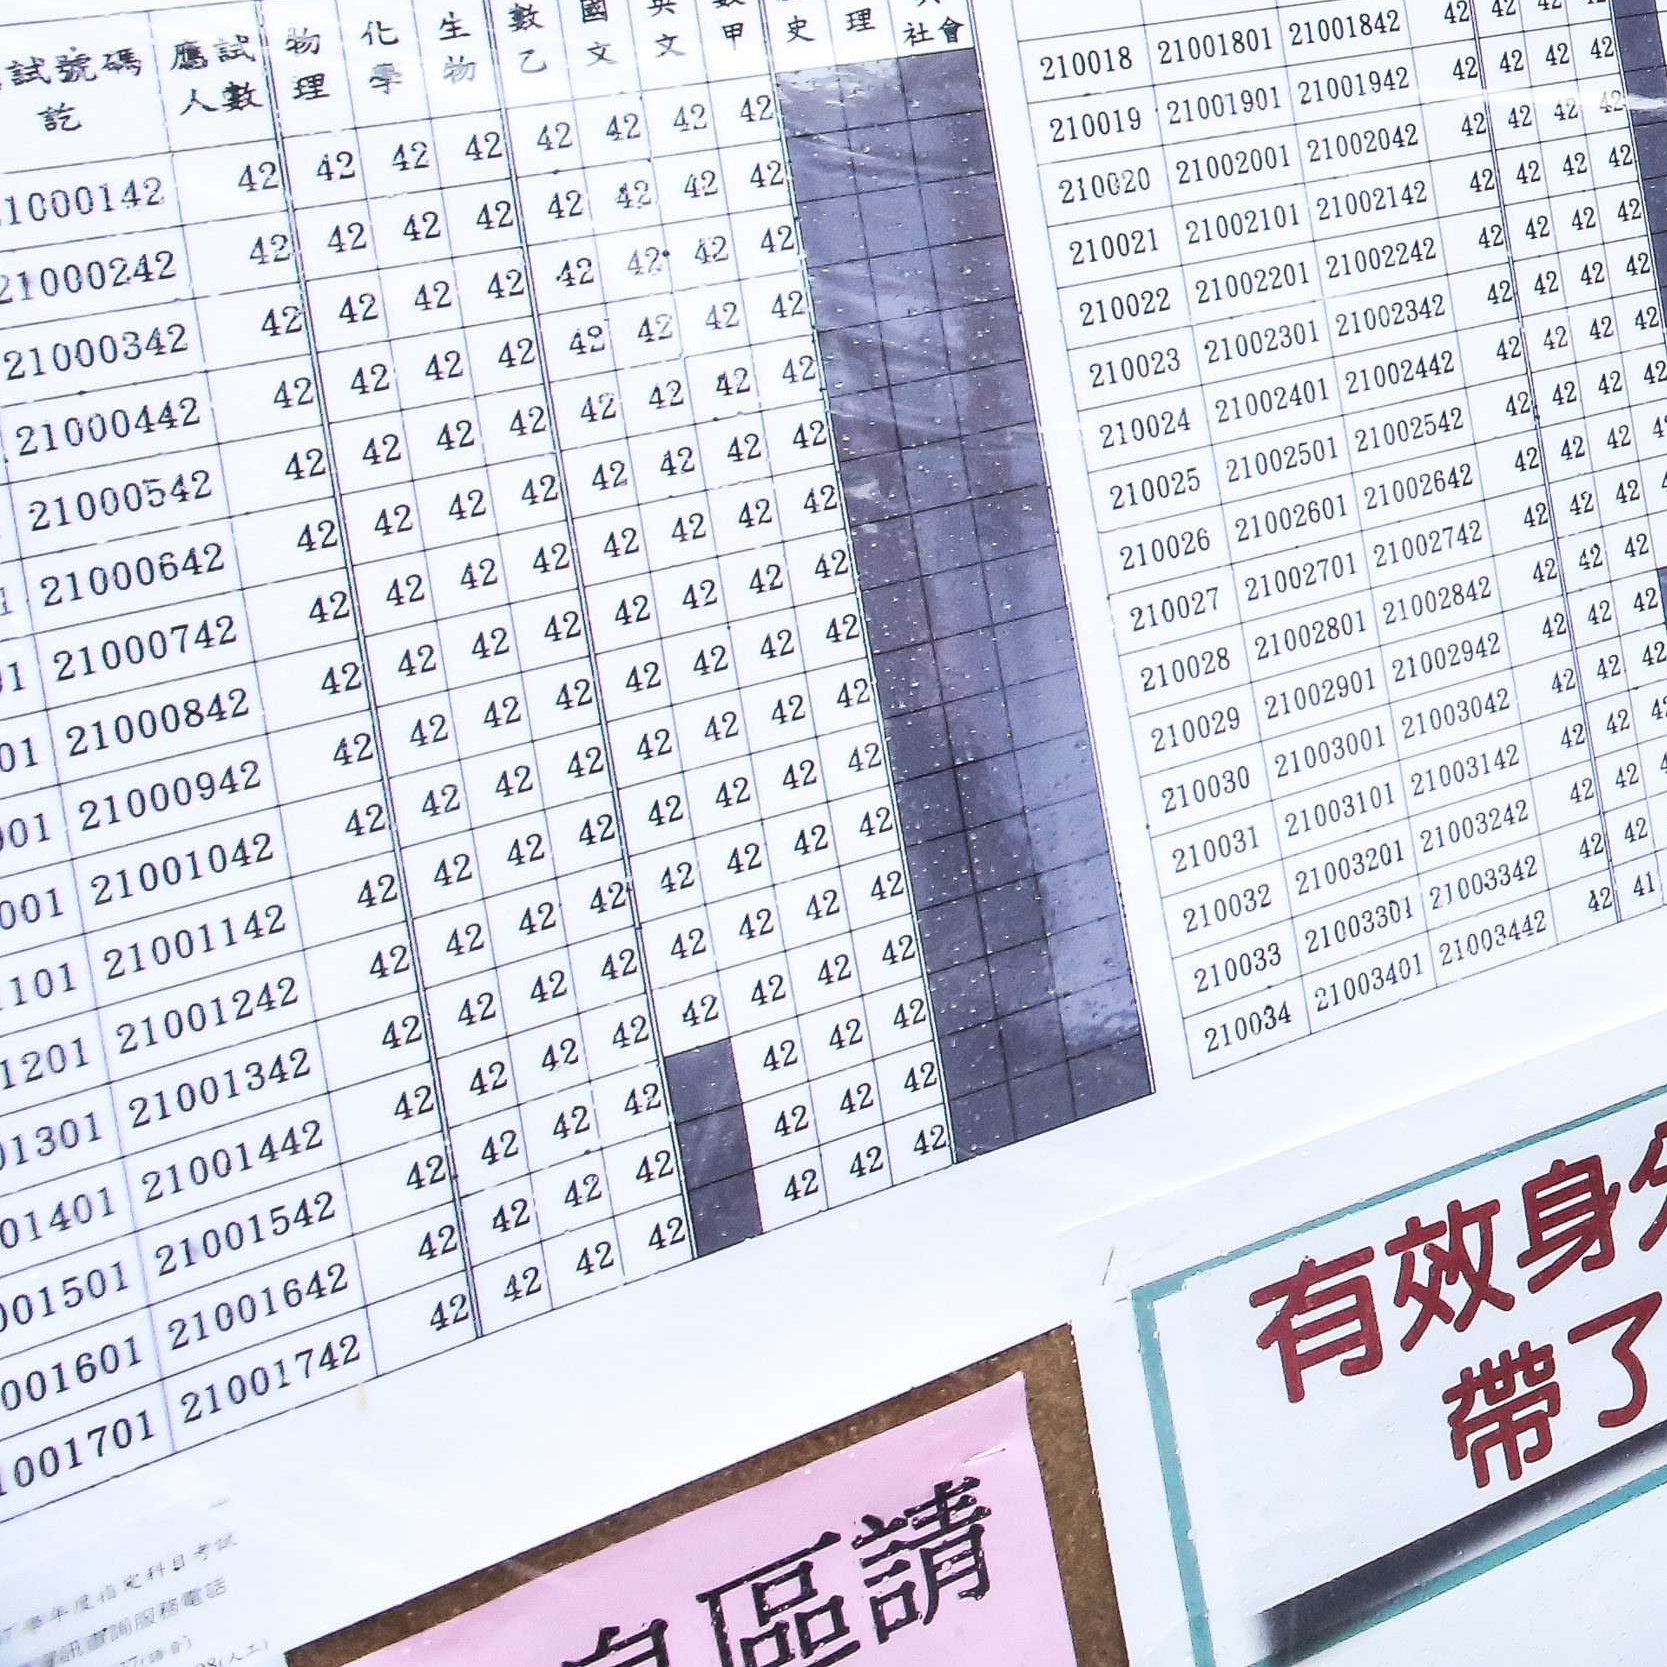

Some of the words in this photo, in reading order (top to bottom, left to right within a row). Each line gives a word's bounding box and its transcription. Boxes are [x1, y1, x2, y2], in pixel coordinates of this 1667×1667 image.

[0, 47, 142, 91] 試號碼
[902, 15, 966, 49] 社會
[1040, 45, 1134, 82] 210018
[1157, 26, 1273, 65] 21001801
[1288, 9, 1401, 47] 21001842
[1444, 0, 1470, 24] 42
[179, 80, 264, 117] 人數
[4, 322, 190, 380] 21000342
[1089, 348, 1182, 388] 210023
[1203, 319, 1321, 365] 21002301
[1335, 294, 1447, 338] 21002342
[1119, 527, 1212, 572] 210026
[78, 759, 262, 832] 21000942
[1203, 1001, 1293, 1054] 210034
[1313, 953, 1425, 1013] 21003401
[1437, 909, 1548, 967] 21003442
[1588, 886, 1614, 914] 42
[1632, 871, 1657, 899] 41
[127, 1047, 312, 1128] 21001342
[167, 1263, 349, 1350] 21001642
[180, 1333, 361, 1423] 21001742
